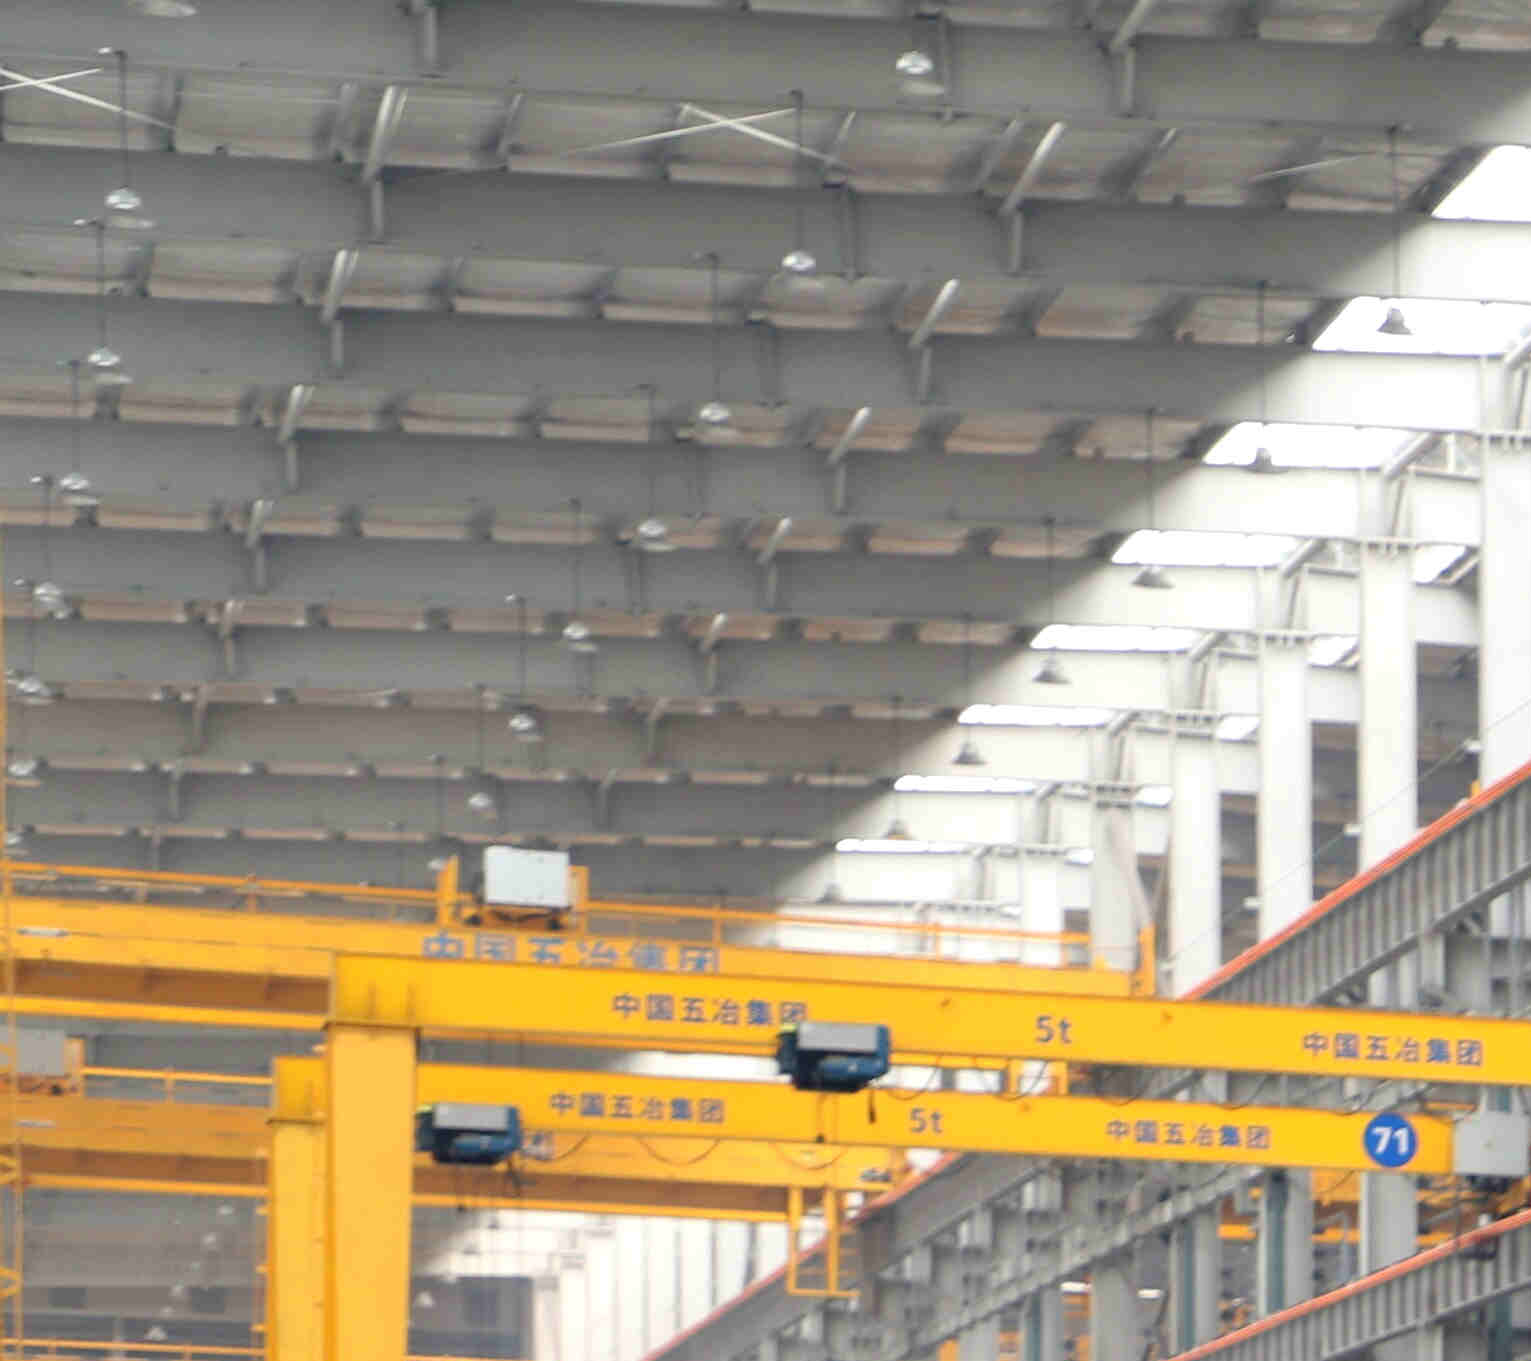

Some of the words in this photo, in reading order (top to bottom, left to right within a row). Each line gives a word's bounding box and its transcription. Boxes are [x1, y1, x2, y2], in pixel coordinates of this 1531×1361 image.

[612, 993, 807, 1026] 中国五冶集团
[1035, 1015, 1072, 1045] 5t
[1302, 1031, 1484, 1067] 中国五冶集团
[549, 1092, 725, 1124] 中国五冶集团
[909, 1108, 943, 1134] 5t
[1105, 1119, 1271, 1151] 中国五冶集团
[1371, 1125, 1410, 1156] 71
